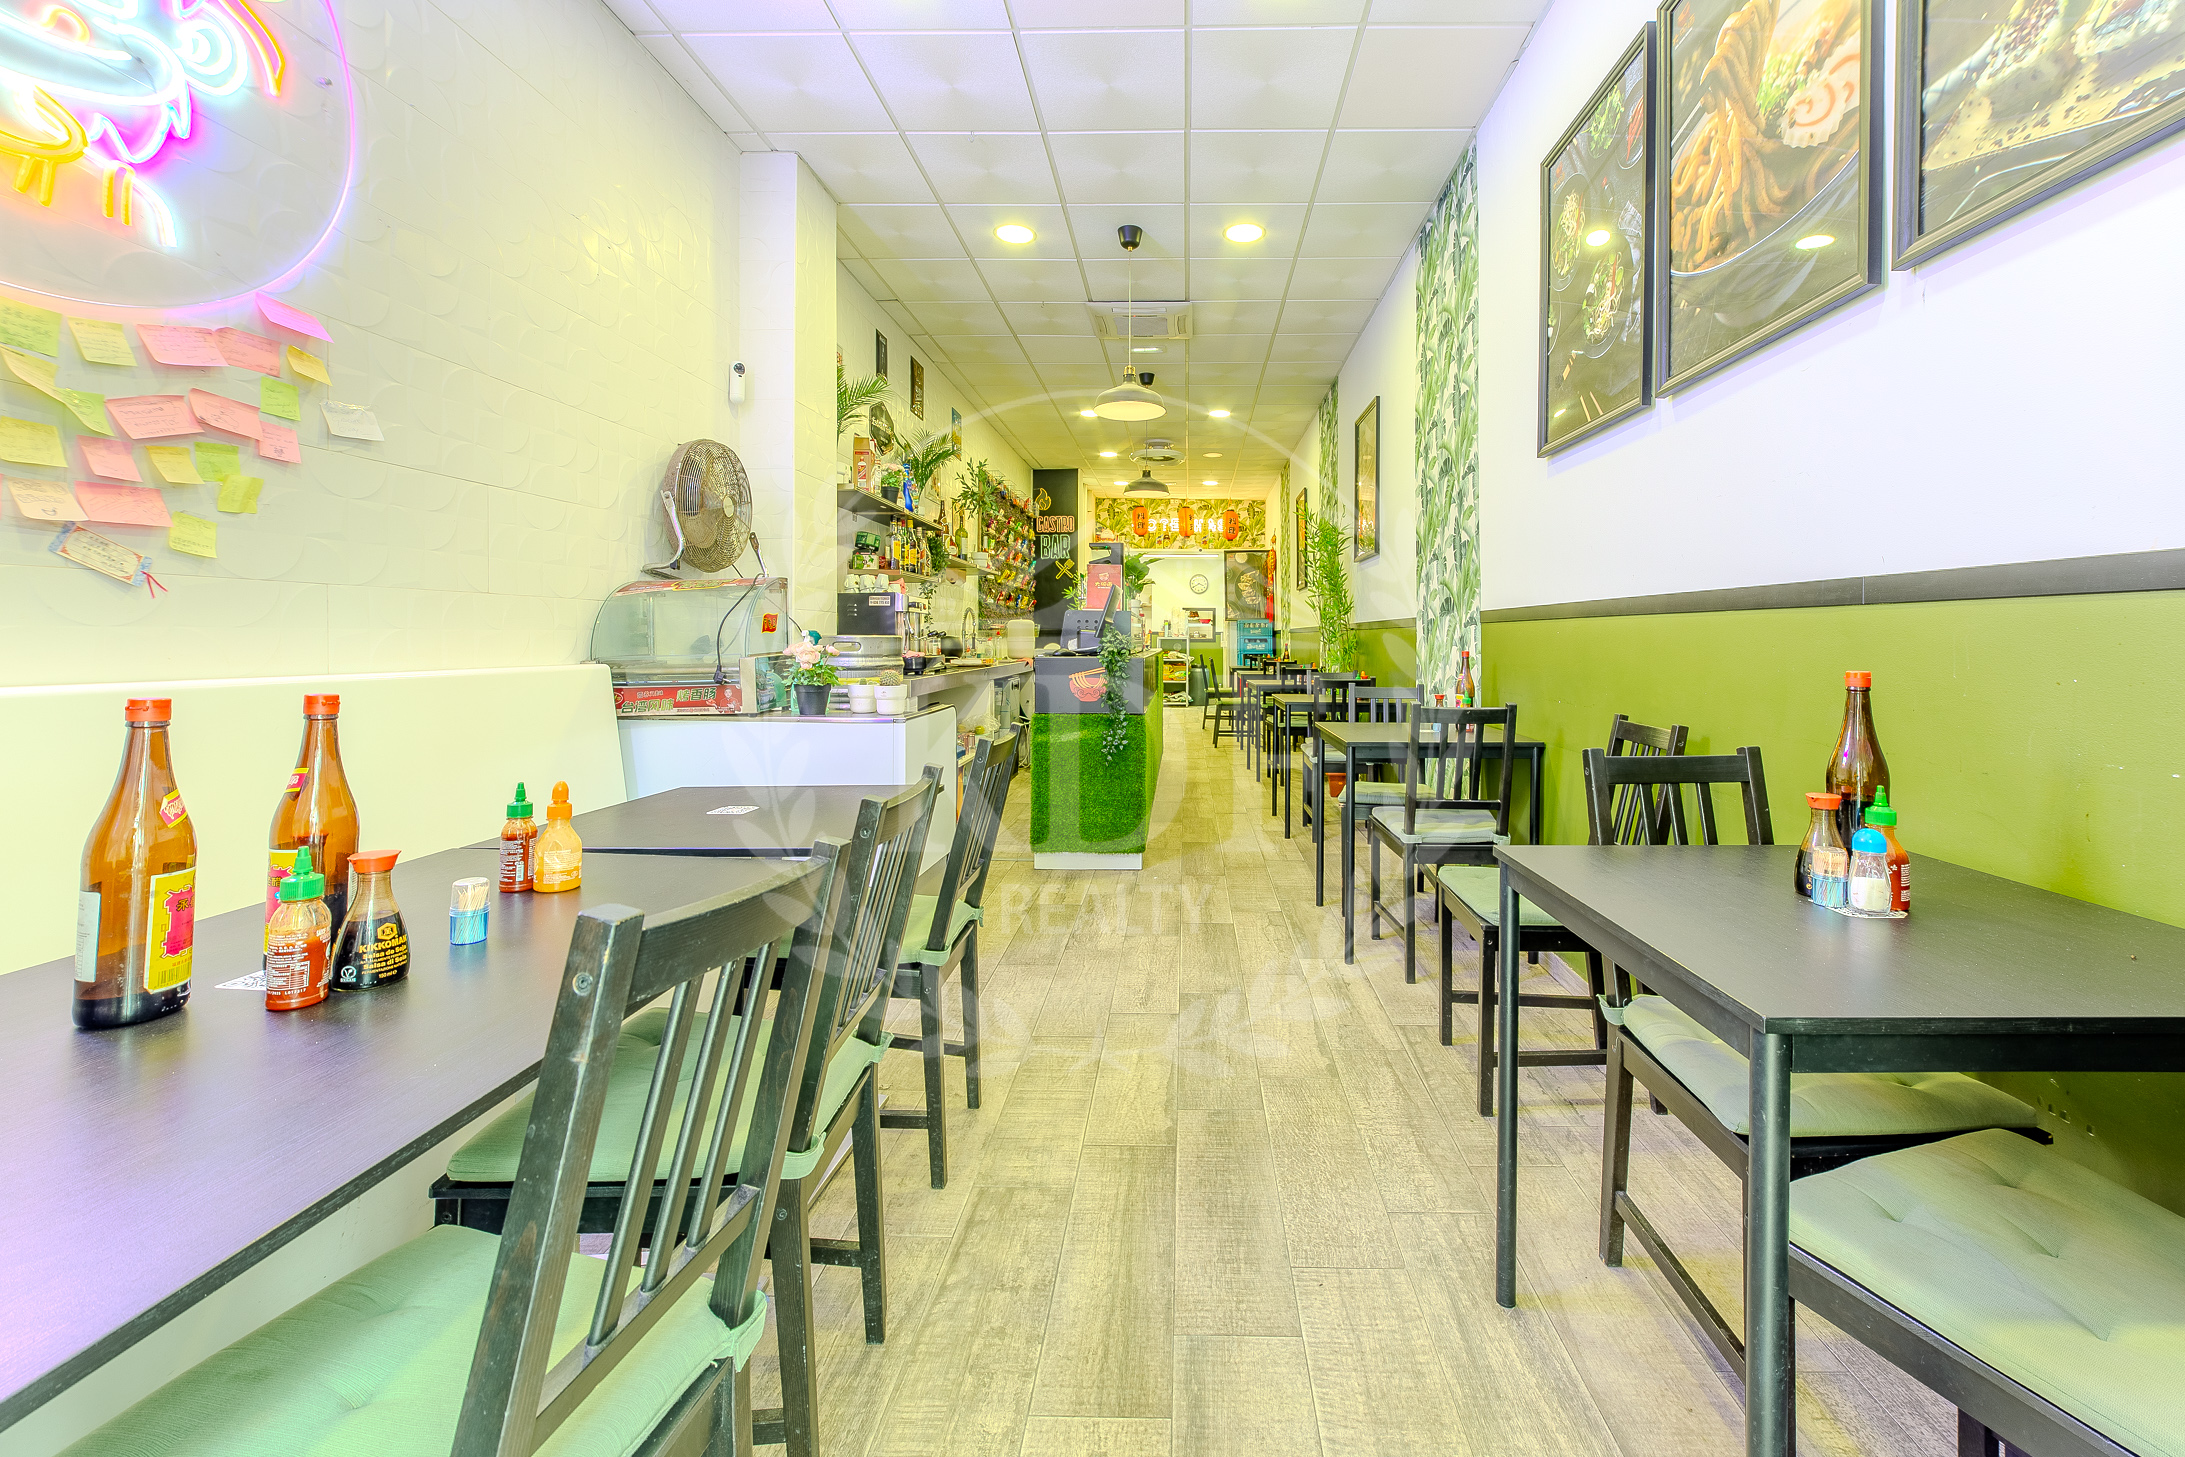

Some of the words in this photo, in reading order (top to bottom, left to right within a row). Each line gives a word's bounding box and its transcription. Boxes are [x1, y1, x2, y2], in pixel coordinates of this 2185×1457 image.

[1036, 516, 1075, 533] GASTRO
[1040, 534, 1071, 560] BAR
[675, 686, 718, 702] 烤香肠
[621, 697, 675, 714] 台湾风味
[358, 934, 407, 954] KIKKOMAN
